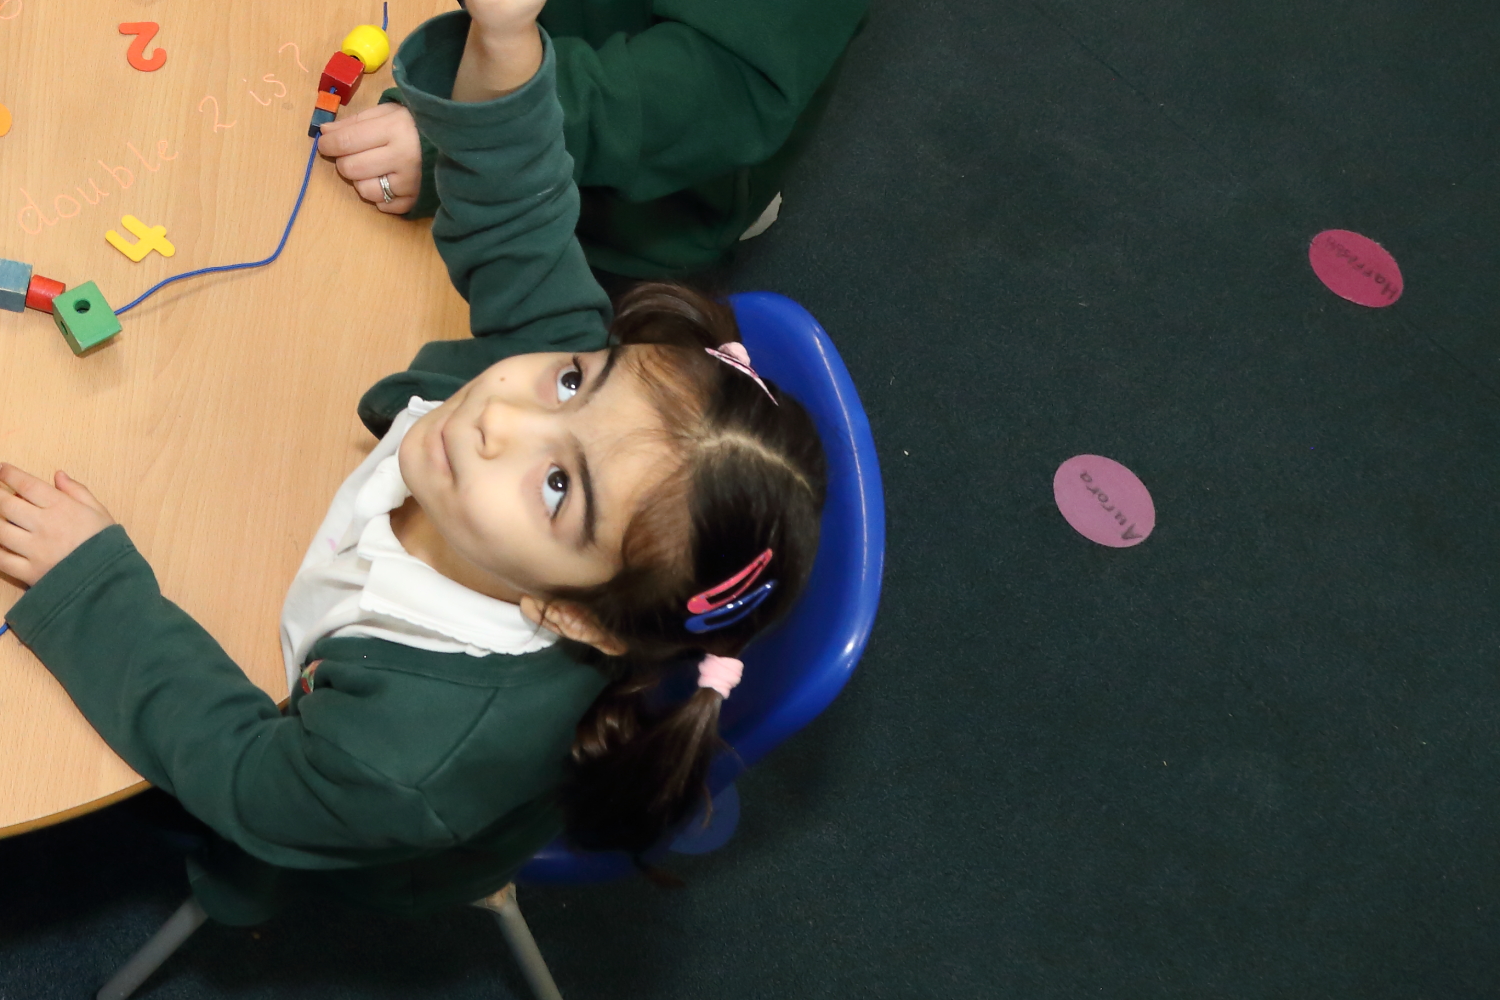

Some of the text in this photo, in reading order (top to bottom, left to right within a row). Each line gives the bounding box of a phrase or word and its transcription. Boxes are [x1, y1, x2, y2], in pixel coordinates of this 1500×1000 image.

[118, 22, 168, 72] 2
[17, 139, 178, 235] double
[199, 95, 237, 133] 2
[105, 214, 176, 262] 4
[1080, 470, 1143, 540] Aurora
